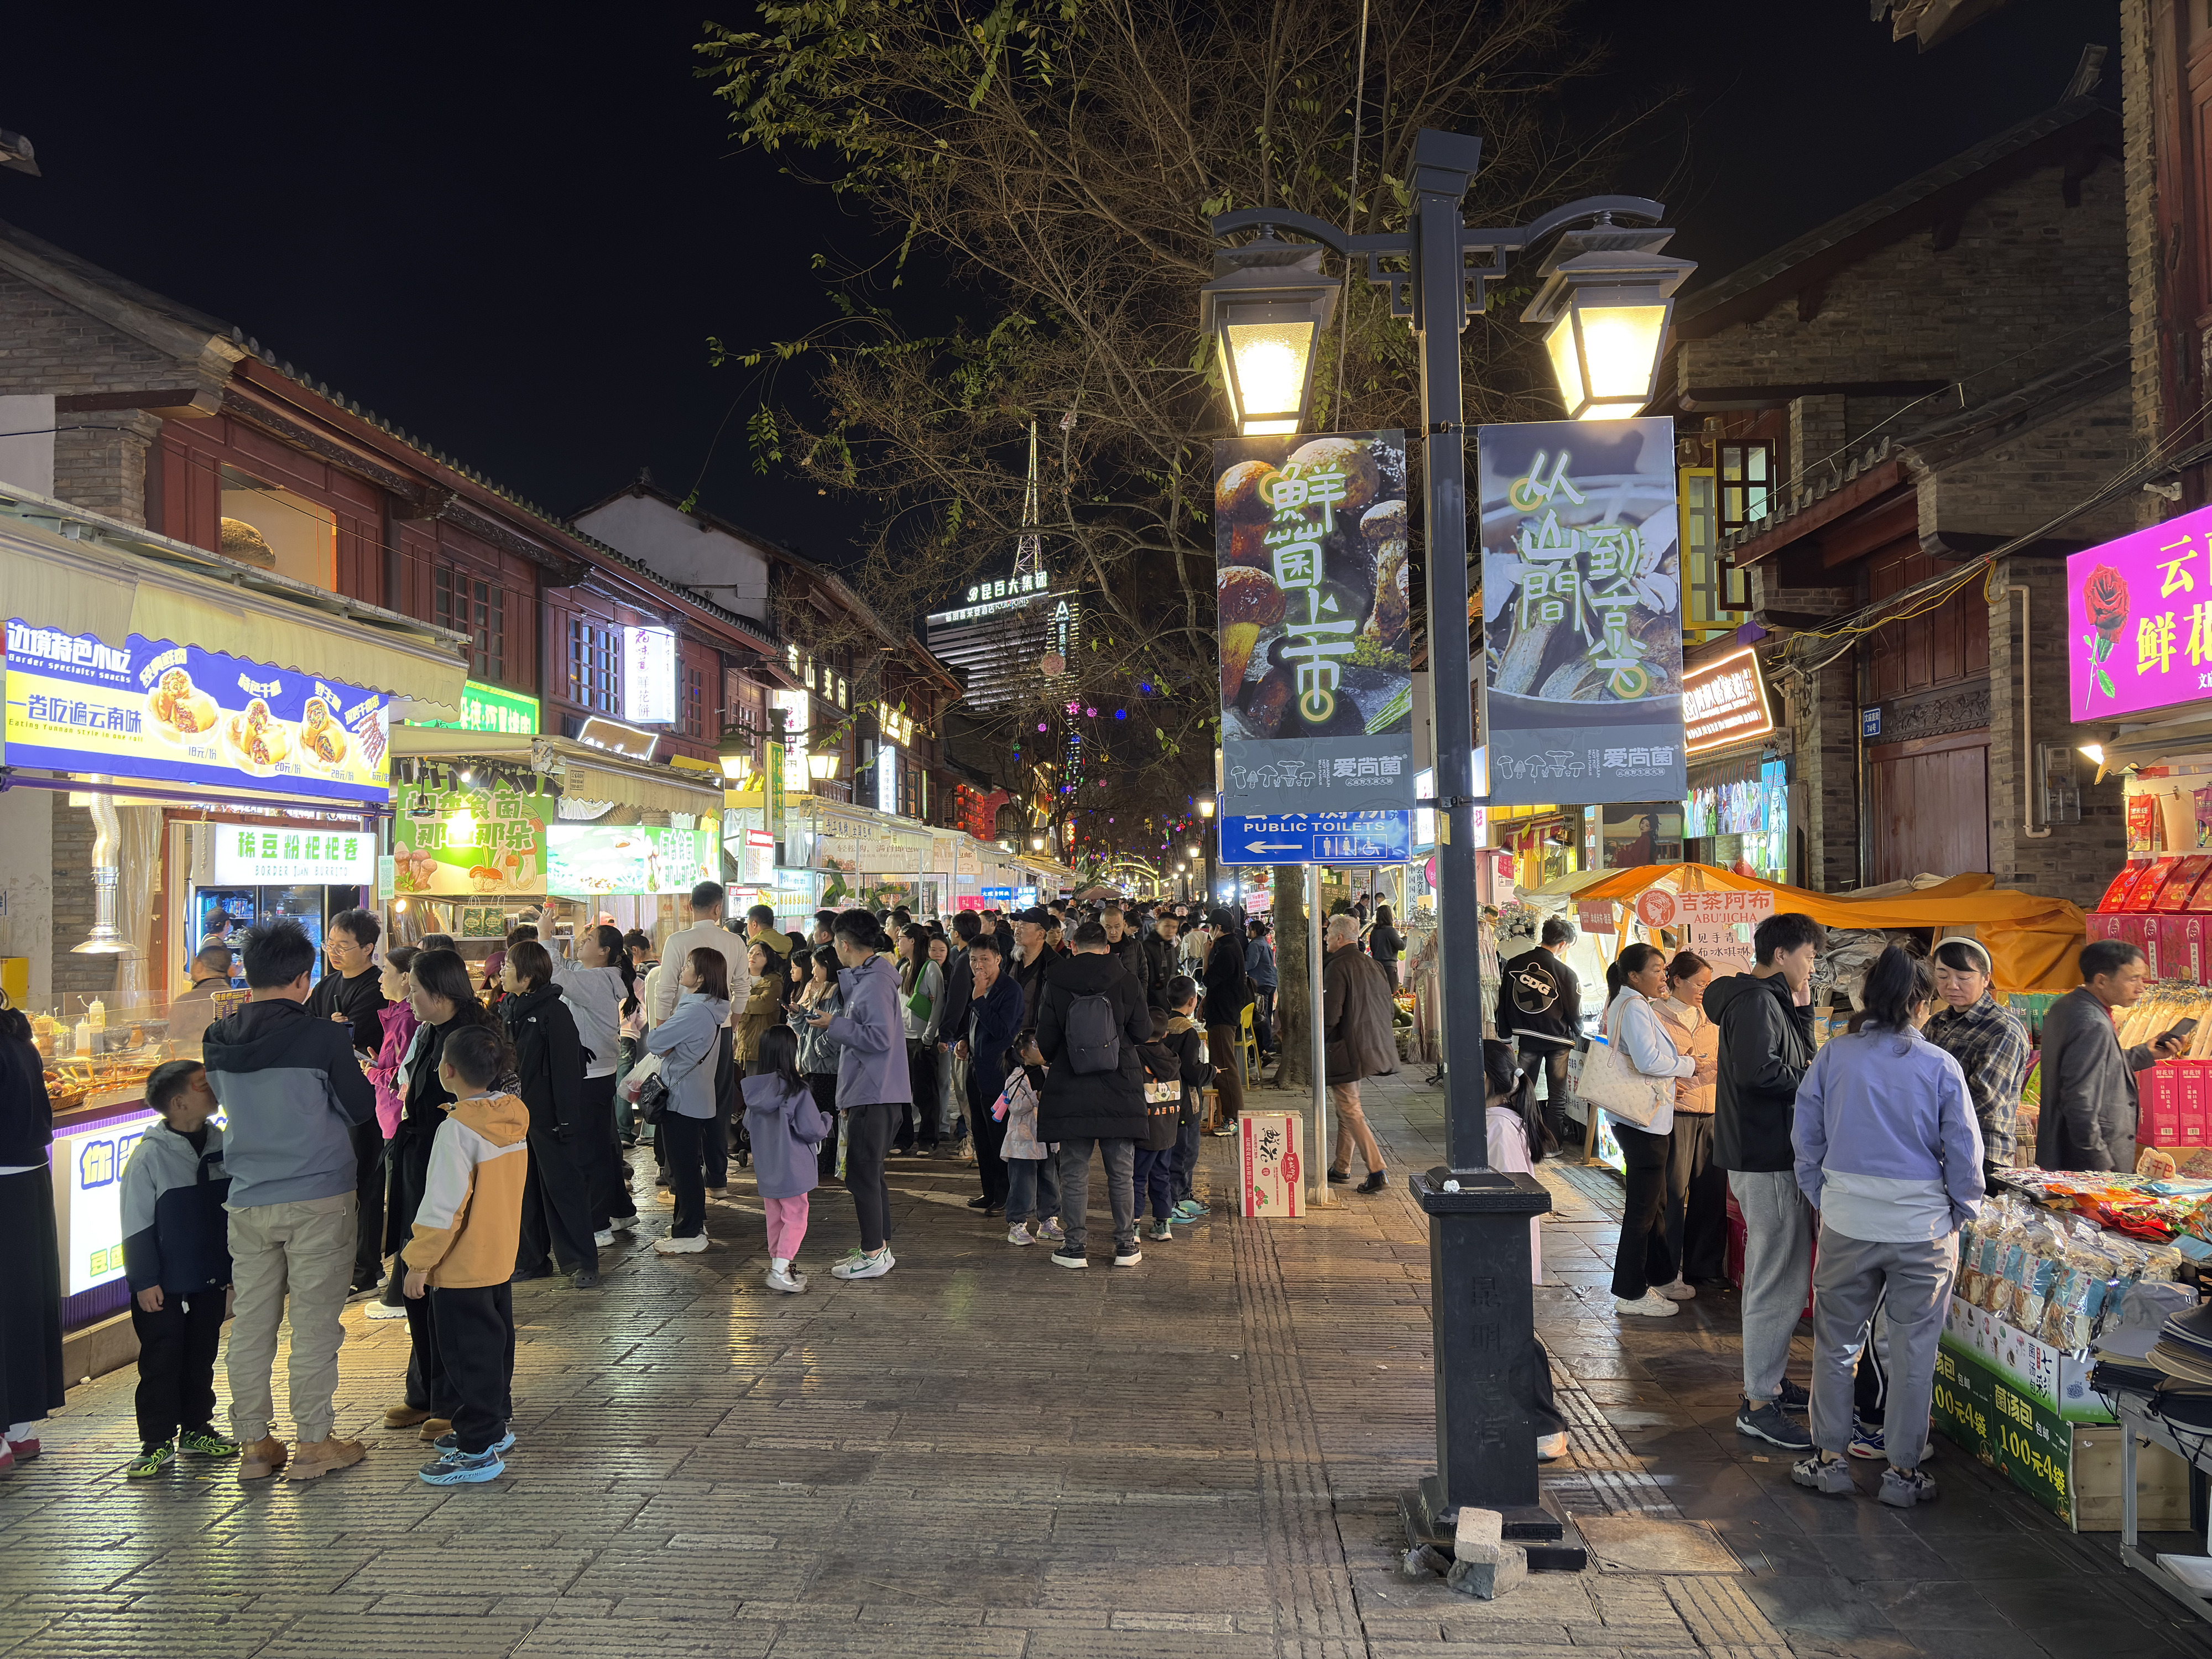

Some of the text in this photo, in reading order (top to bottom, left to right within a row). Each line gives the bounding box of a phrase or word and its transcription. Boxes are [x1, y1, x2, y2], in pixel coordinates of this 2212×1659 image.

[2157, 531, 2212, 598] 云
[982, 571, 1047, 601] 昆百大集团
[946, 603, 995, 622] 福朋喜来登酒店
[8, 623, 131, 674] 边境特色小吃
[8, 654, 44, 667] Border
[7, 694, 142, 733] 一卷吃遍云南味
[1865, 712, 1879, 722] 文庙直街
[9, 719, 39, 729] Eating
[43, 724, 73, 733] Yunnan
[77, 729, 98, 737] style
[1867, 723, 1876, 733] 74号
[189, 746, 217, 760] 18元/份
[1603, 747, 1674, 768] 爱尚菌
[275, 762, 301, 774] 20元/份
[331, 769, 354, 781] 28元/份
[1333, 755, 1402, 778] 爱尚菌
[1616, 767, 1666, 777] 云南野生菌火锅
[372, 771, 389, 782] 6元/串
[1345, 776, 1394, 786] 云南野生菌火锅
[1244, 822, 1385, 832] PUBLIC TOILETS
[238, 831, 358, 860] 稀豆粉粑粑卷
[255, 865, 289, 877] BORDER
[315, 865, 348, 877] BURRITO
[1678, 891, 1771, 911] 吉茶阿布
[1694, 912, 1757, 924] ABU'JICHA
[1698, 932, 1734, 943] 见手青
[1520, 974, 1551, 995] CDG
[2151, 1159, 2172, 1178] 干巴
[2028, 1342, 2036, 1396] 菌汤包
[2036, 1349, 2052, 1399] 七彩
[1957, 1372, 1971, 1390] 包邮
[1931, 1384, 1987, 1439] 00元4袋
[1994, 1384, 2033, 1431] 菌汤包
[2035, 1420, 2049, 1442] 包邮
[2000, 1424, 2065, 1495] 100元4袋
